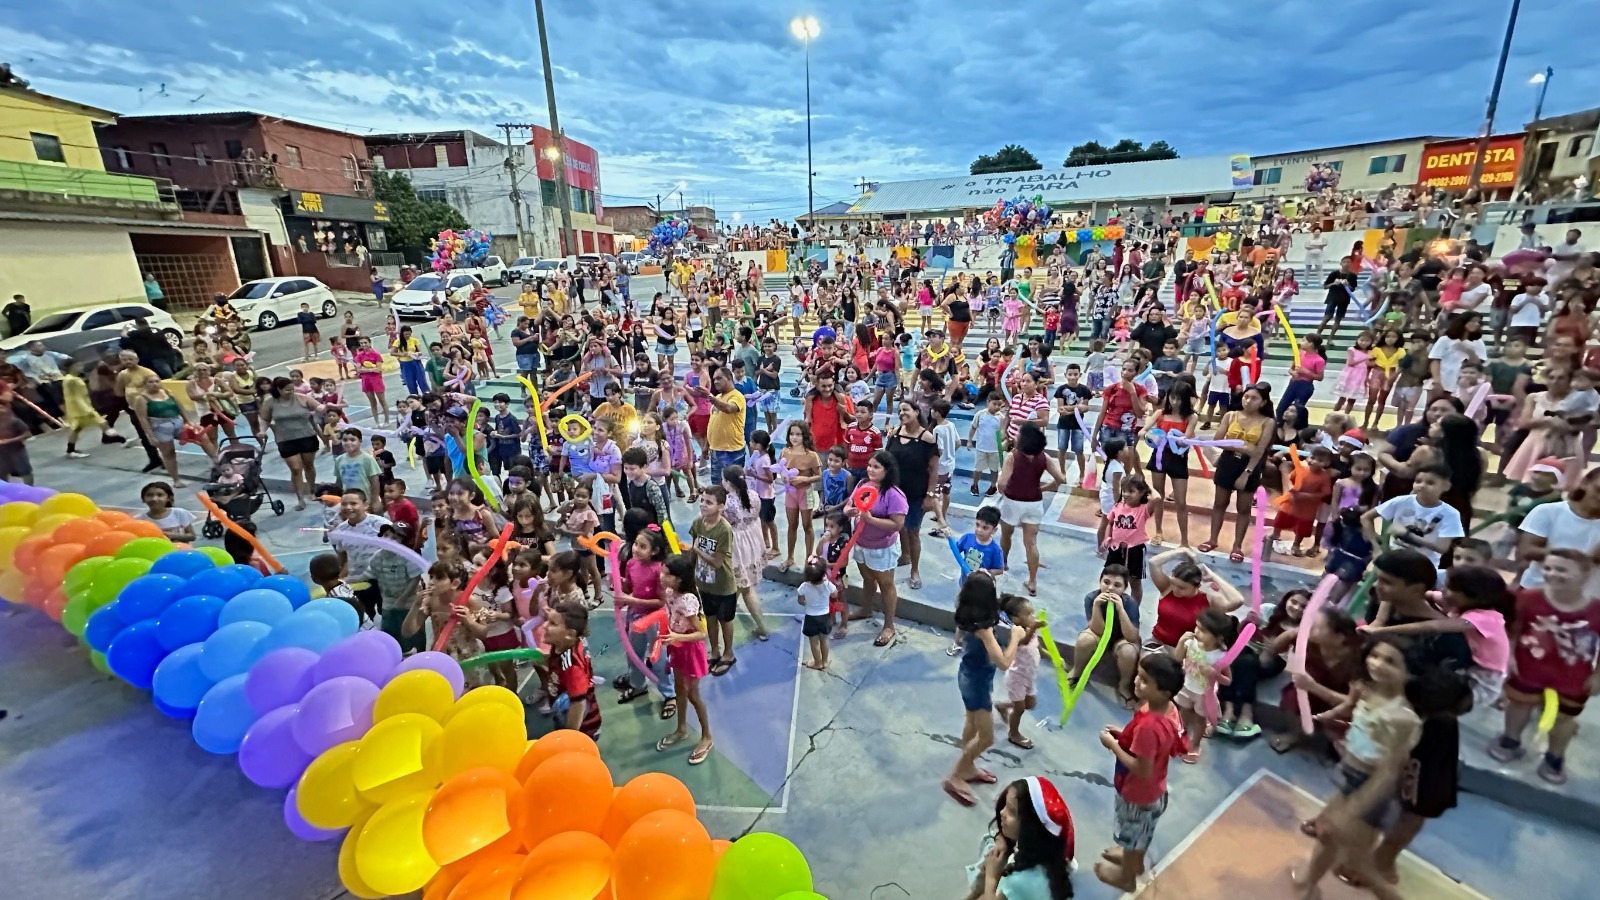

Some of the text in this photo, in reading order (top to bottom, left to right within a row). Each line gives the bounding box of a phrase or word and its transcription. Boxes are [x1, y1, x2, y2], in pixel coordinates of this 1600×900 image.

[1426, 147, 1515, 169] DENTISTA
[984, 169, 1112, 185] TRABALHO
[1018, 181, 1079, 192] PARA
